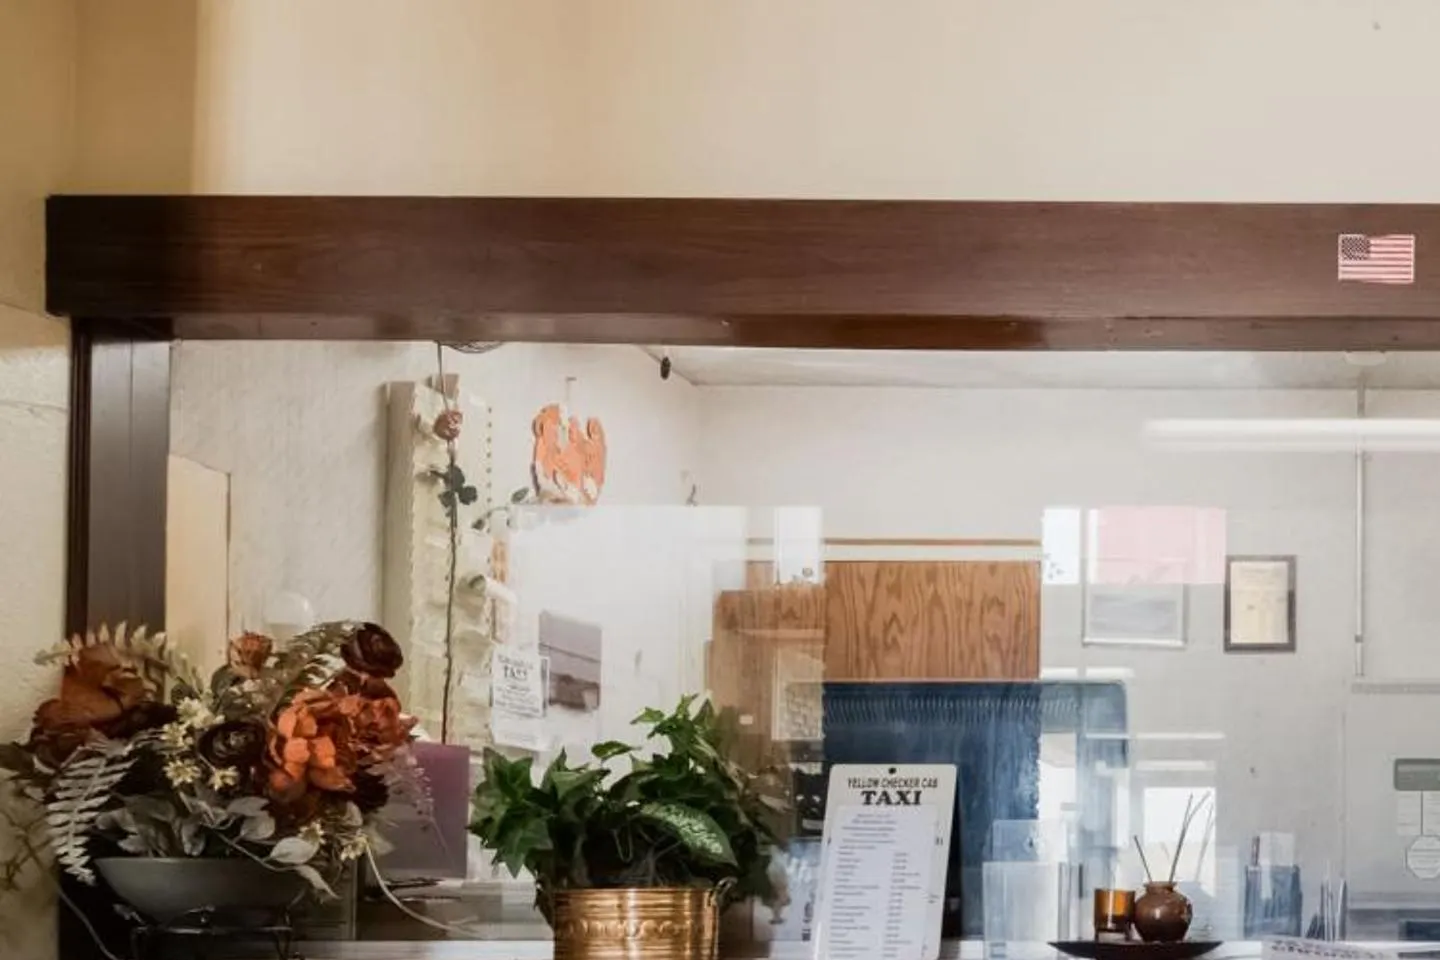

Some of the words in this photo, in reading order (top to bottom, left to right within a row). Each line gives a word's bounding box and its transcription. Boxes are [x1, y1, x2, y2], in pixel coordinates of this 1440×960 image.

[847, 777, 879, 789] YELLOW
[880, 777, 919, 789] CHECKER
[921, 777, 938, 788] CAB
[861, 790, 922, 806] TAXI
